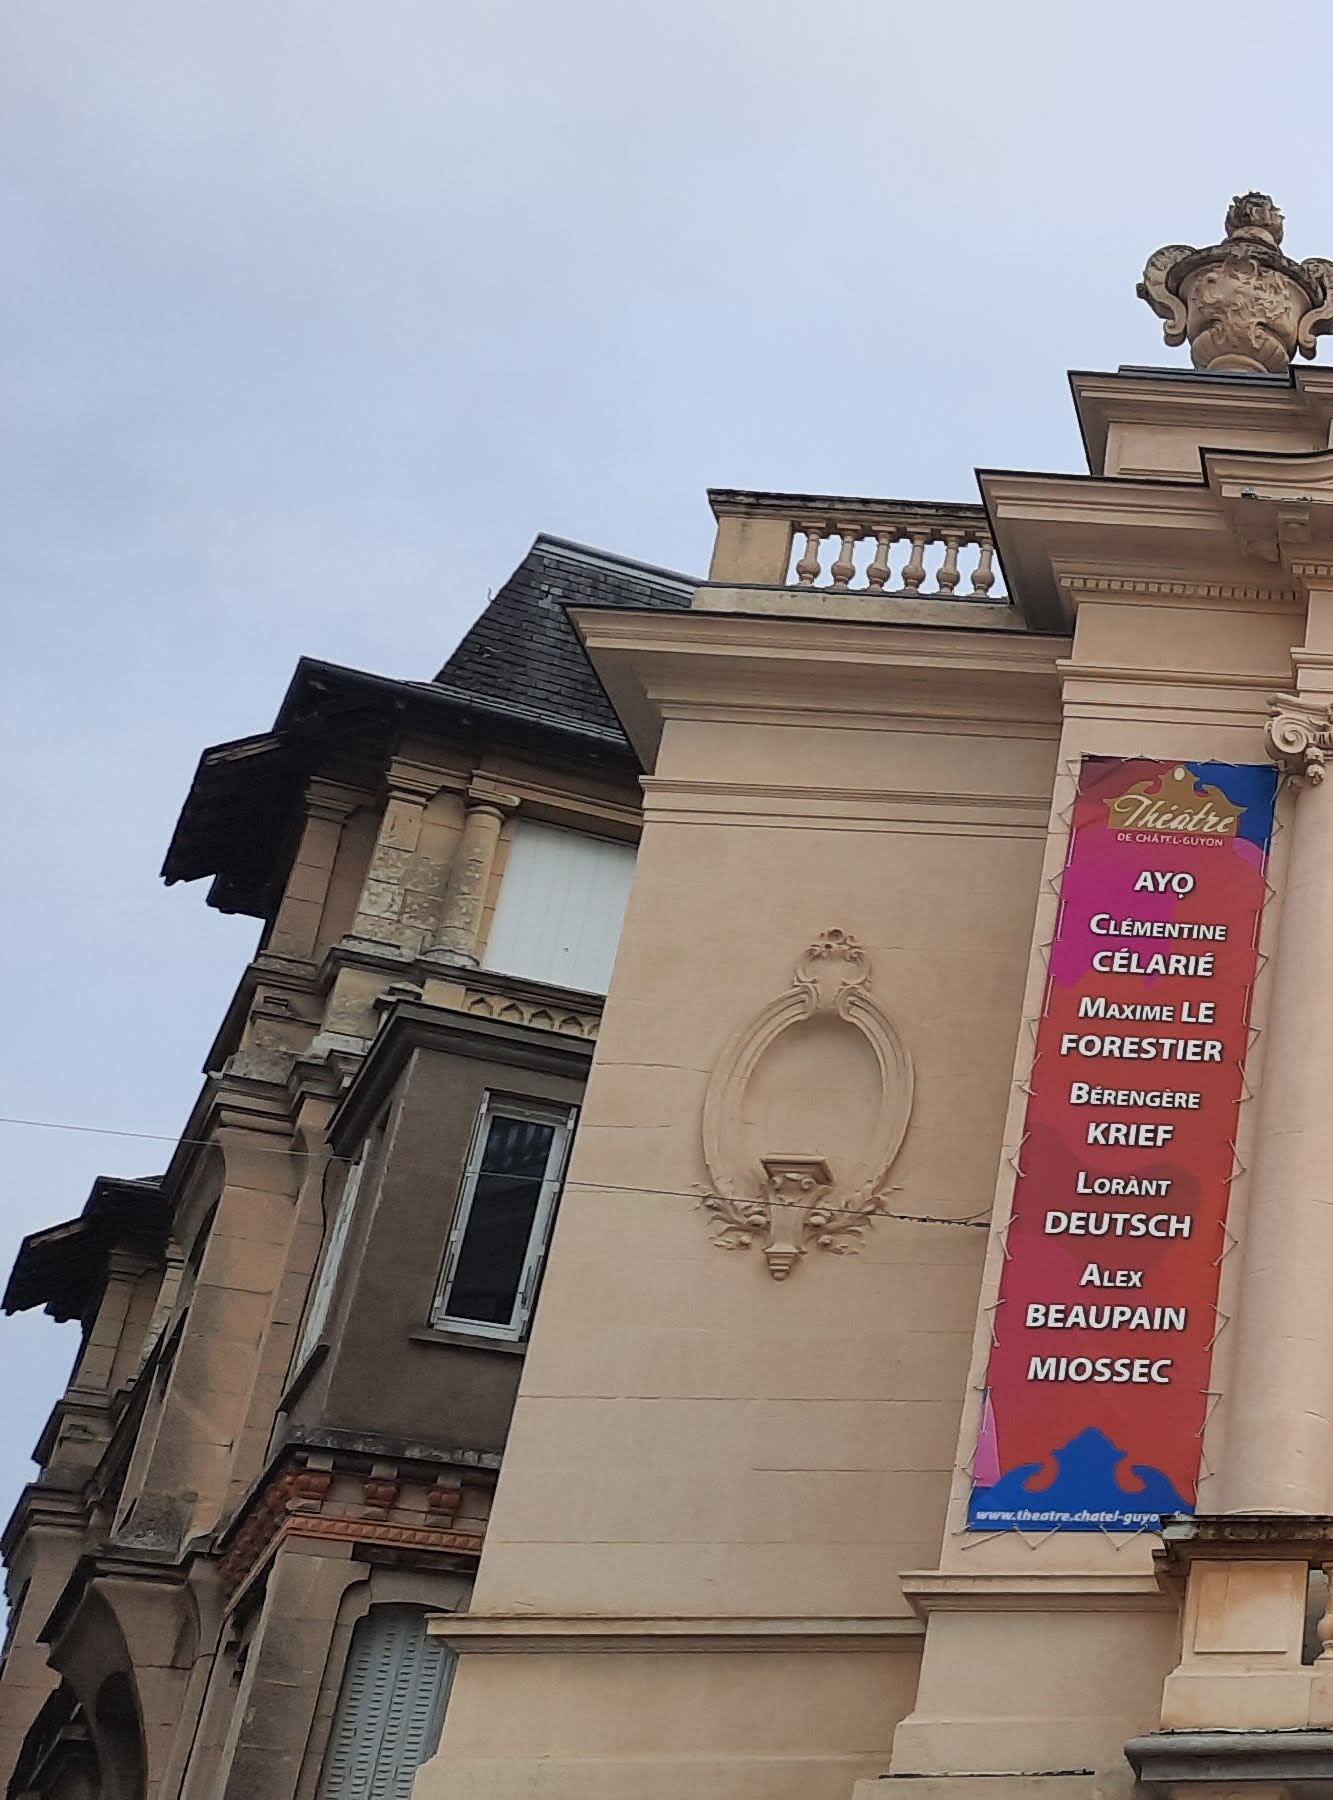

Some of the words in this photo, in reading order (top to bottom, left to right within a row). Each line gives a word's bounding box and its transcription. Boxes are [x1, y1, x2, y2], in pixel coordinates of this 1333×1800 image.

[1113, 794, 1235, 833] Théâtre
[1117, 832, 1132, 842] DE
[1090, 913, 1227, 941] CLÉMENTINE
[1092, 948, 1214, 977] CÉLARIÉ
[1078, 996, 1174, 1022] MAXIME
[1181, 1001, 1215, 1023] LE
[1060, 1034, 1223, 1062] FORESTIER
[1070, 1082, 1201, 1109] BÉRENGÈRE
[1087, 1122, 1174, 1147] KRIEF
[1044, 1211, 1191, 1238] DEUTSCH
[1079, 1263, 1143, 1288] ALEX
[1025, 1303, 1186, 1331] BEAUPAIN
[1027, 1356, 1172, 1383] MIOSSEC
